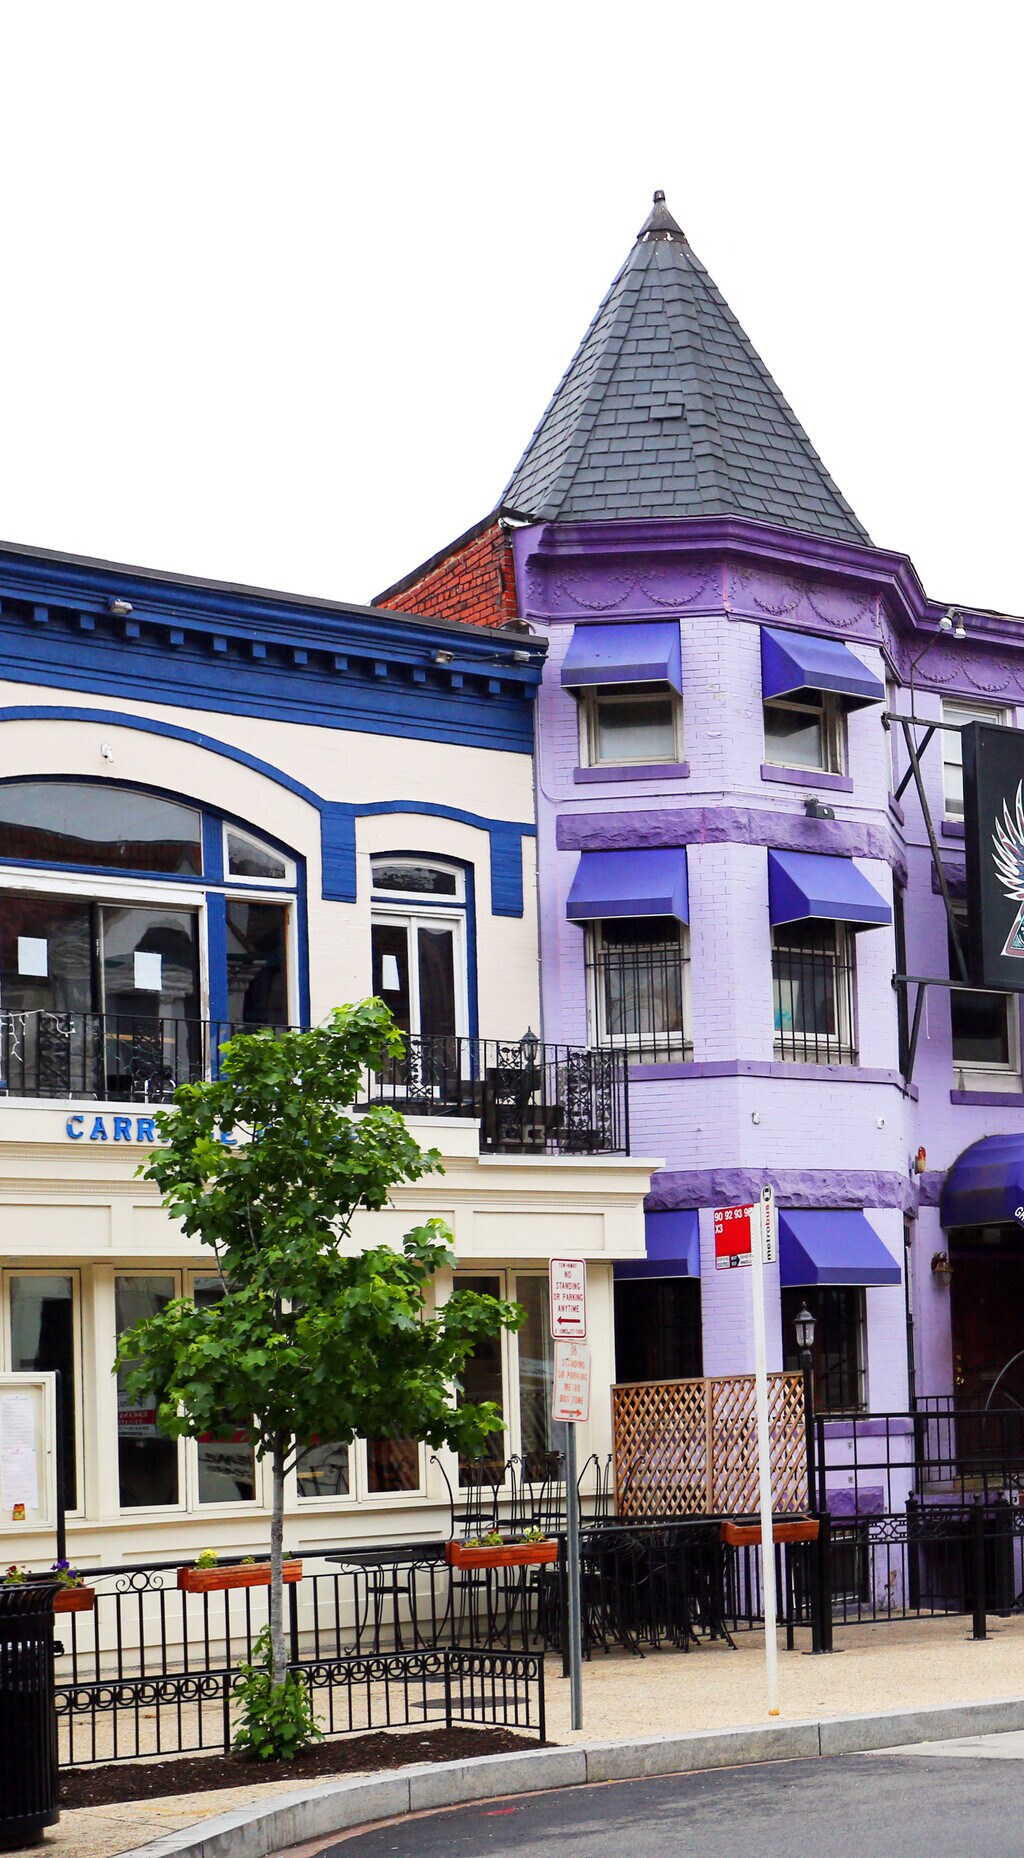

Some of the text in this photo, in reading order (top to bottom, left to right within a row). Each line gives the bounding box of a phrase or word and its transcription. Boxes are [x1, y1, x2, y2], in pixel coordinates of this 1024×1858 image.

[715, 1212, 723, 1222] 90
[724, 1210, 733, 1220] 92
[734, 1208, 743, 1218] 93
[564, 1271, 571, 1279] NO
[556, 1281, 581, 1291] STANDING
[554, 1293, 583, 1302] OR PARKING
[558, 1304, 580, 1313] ANYTIME
